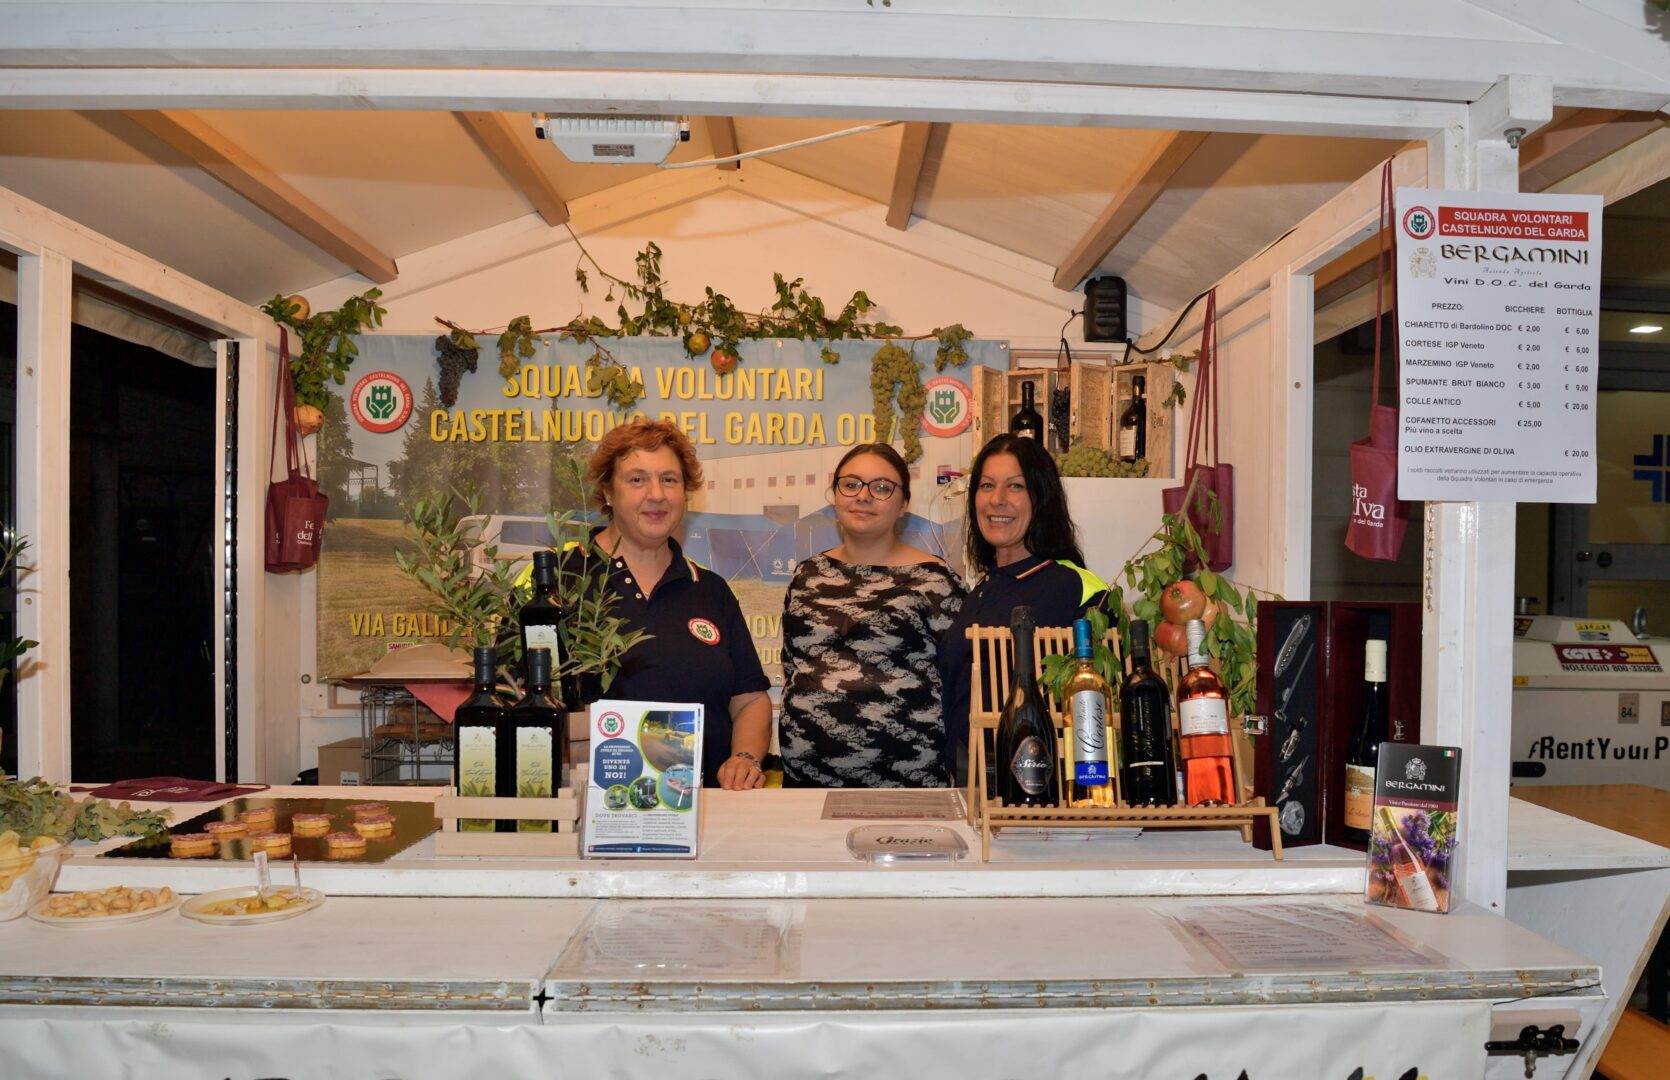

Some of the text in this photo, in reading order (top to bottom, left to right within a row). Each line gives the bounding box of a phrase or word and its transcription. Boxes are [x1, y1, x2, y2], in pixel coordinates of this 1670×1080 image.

[1454, 210, 1573, 224] SQUADRA VOLONTARI
[1442, 224, 1586, 239] CASTELNUOVO DEL GARDA
[1440, 244, 1589, 264] BERGAMINI
[1475, 278, 1522, 287] D.O.C.
[1528, 280, 1548, 288] del
[1554, 281, 1591, 290] Garda
[1432, 302, 1593, 316] PREZZO: BICCHIERE BOTTIGLIA
[1404, 320, 1449, 328] CHIARETTO
[1459, 322, 1495, 330] Bardolino
[1495, 323, 1513, 331] DOC
[1526, 325, 1541, 333] 2,00
[1405, 339, 1442, 347] CORTESE
[1460, 341, 1485, 349] Veneto
[1406, 359, 1452, 367] MARZEMINO
[503, 364, 824, 401] SQUADA VOLONTARI
[1406, 378, 1448, 386] SPUMANTE
[1476, 380, 1506, 389] BIANCO
[1572, 403, 1589, 411] 20,00
[1405, 416, 1451, 424] COFANETTO
[1452, 418, 1496, 426] ACCESSORI
[725, 412, 826, 446] GARDA
[1441, 427, 1463, 436] scelta
[1424, 445, 1482, 455] EXTRAVERGINE
[1492, 447, 1515, 455] OLIVA
[1572, 449, 1589, 458] 20,00
[350, 612, 386, 637] VIA
[1562, 663, 1610, 673] NOLEGGIO
[604, 771, 627, 779] NOI!
[1385, 780, 1446, 792] BERGAMINI
[876, 836, 934, 845] Grazie
